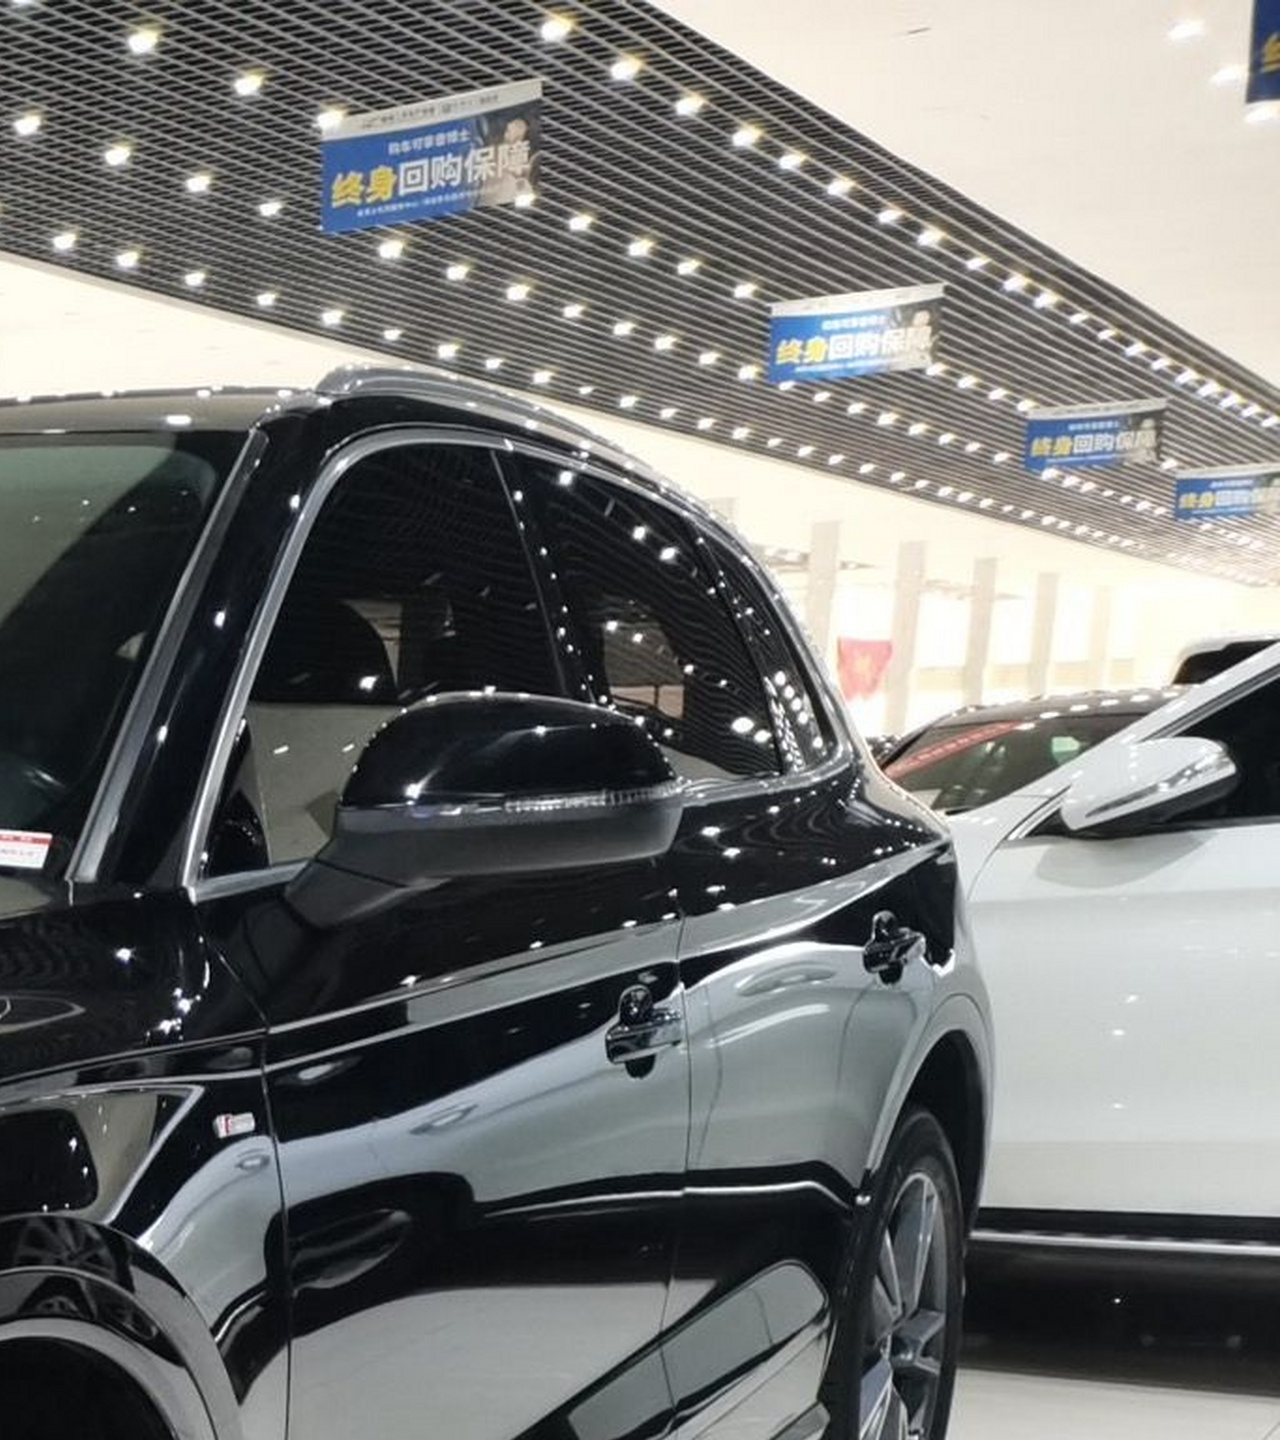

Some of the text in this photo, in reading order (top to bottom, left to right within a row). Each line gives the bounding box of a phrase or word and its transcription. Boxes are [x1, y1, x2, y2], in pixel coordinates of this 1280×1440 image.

[330, 140, 532, 209] 终身回购保障
